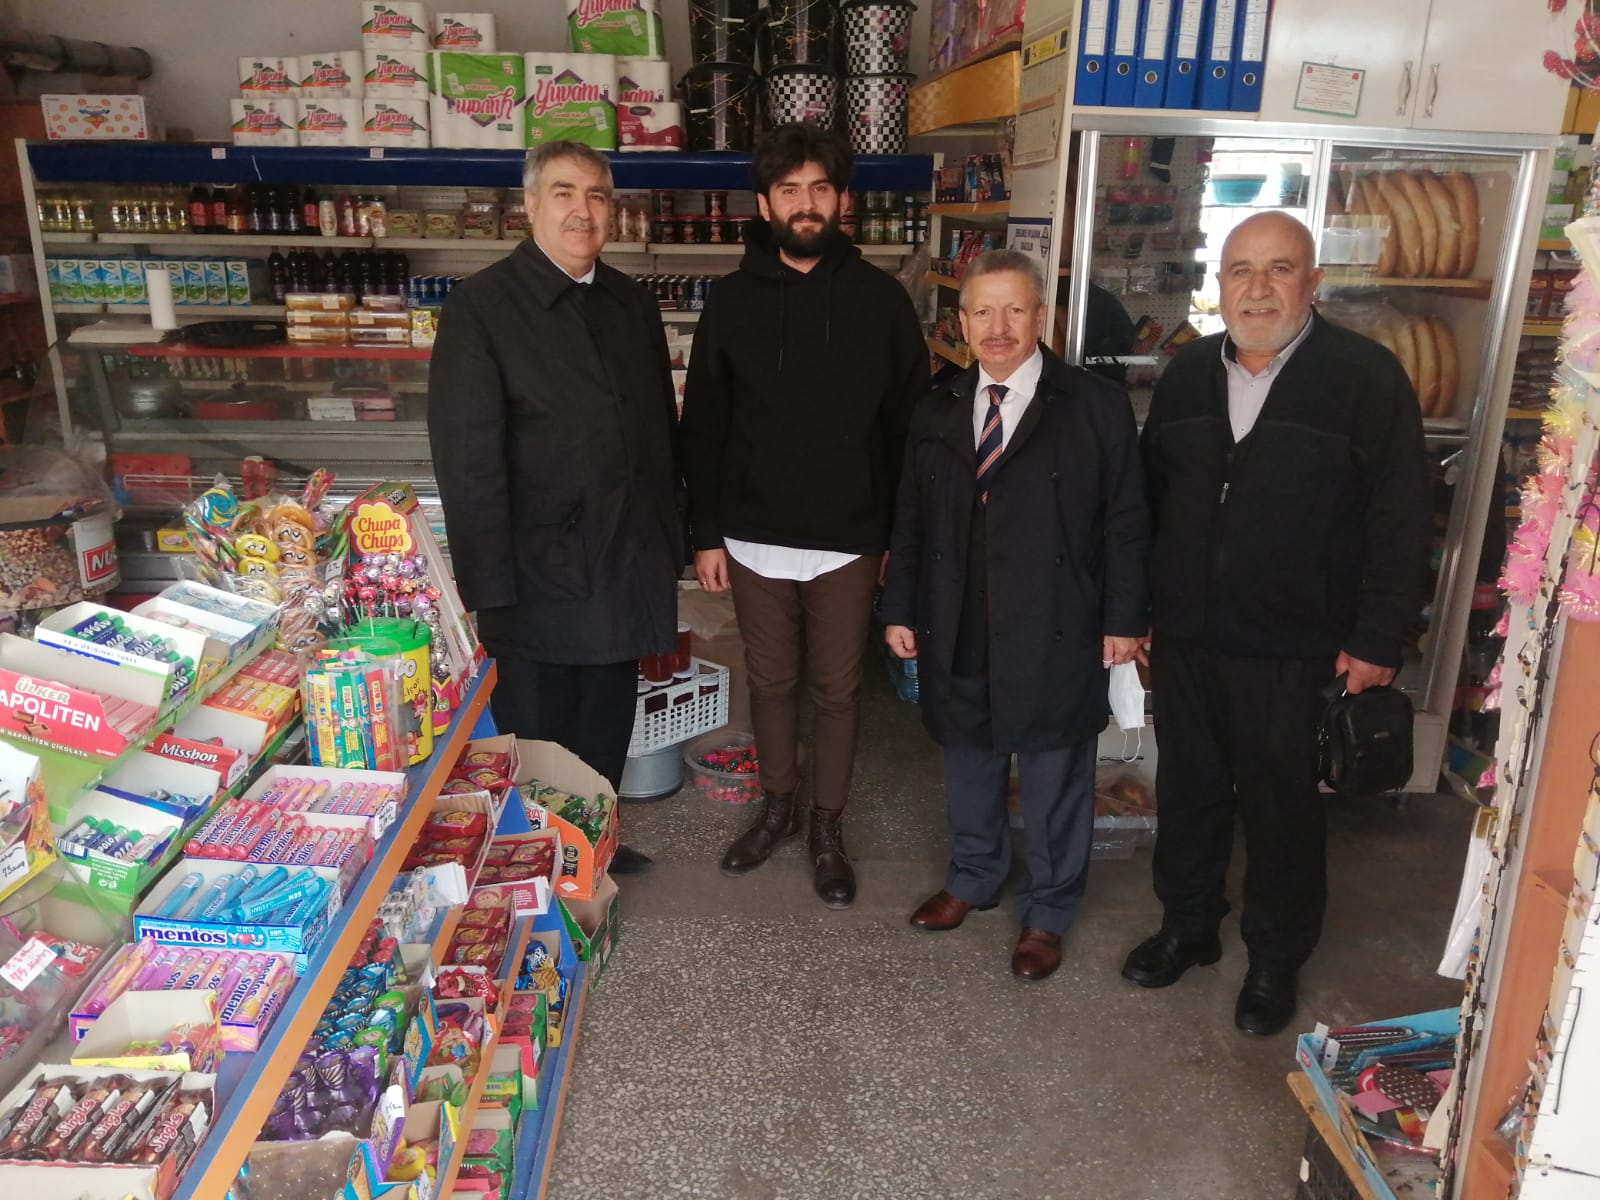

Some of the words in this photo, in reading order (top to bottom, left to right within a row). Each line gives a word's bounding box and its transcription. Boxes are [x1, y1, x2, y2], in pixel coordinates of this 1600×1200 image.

[534, 79, 600, 117] Yuvam
[358, 517, 401, 535] Chupa
[361, 532, 404, 553] Chups
[160, 742, 218, 763] Missbon
[251, 829, 277, 860] mentos
[268, 830, 293, 861] mentos
[295, 842, 315, 865] entos
[140, 927, 227, 945] mentos
[220, 977, 253, 1021] mentos
